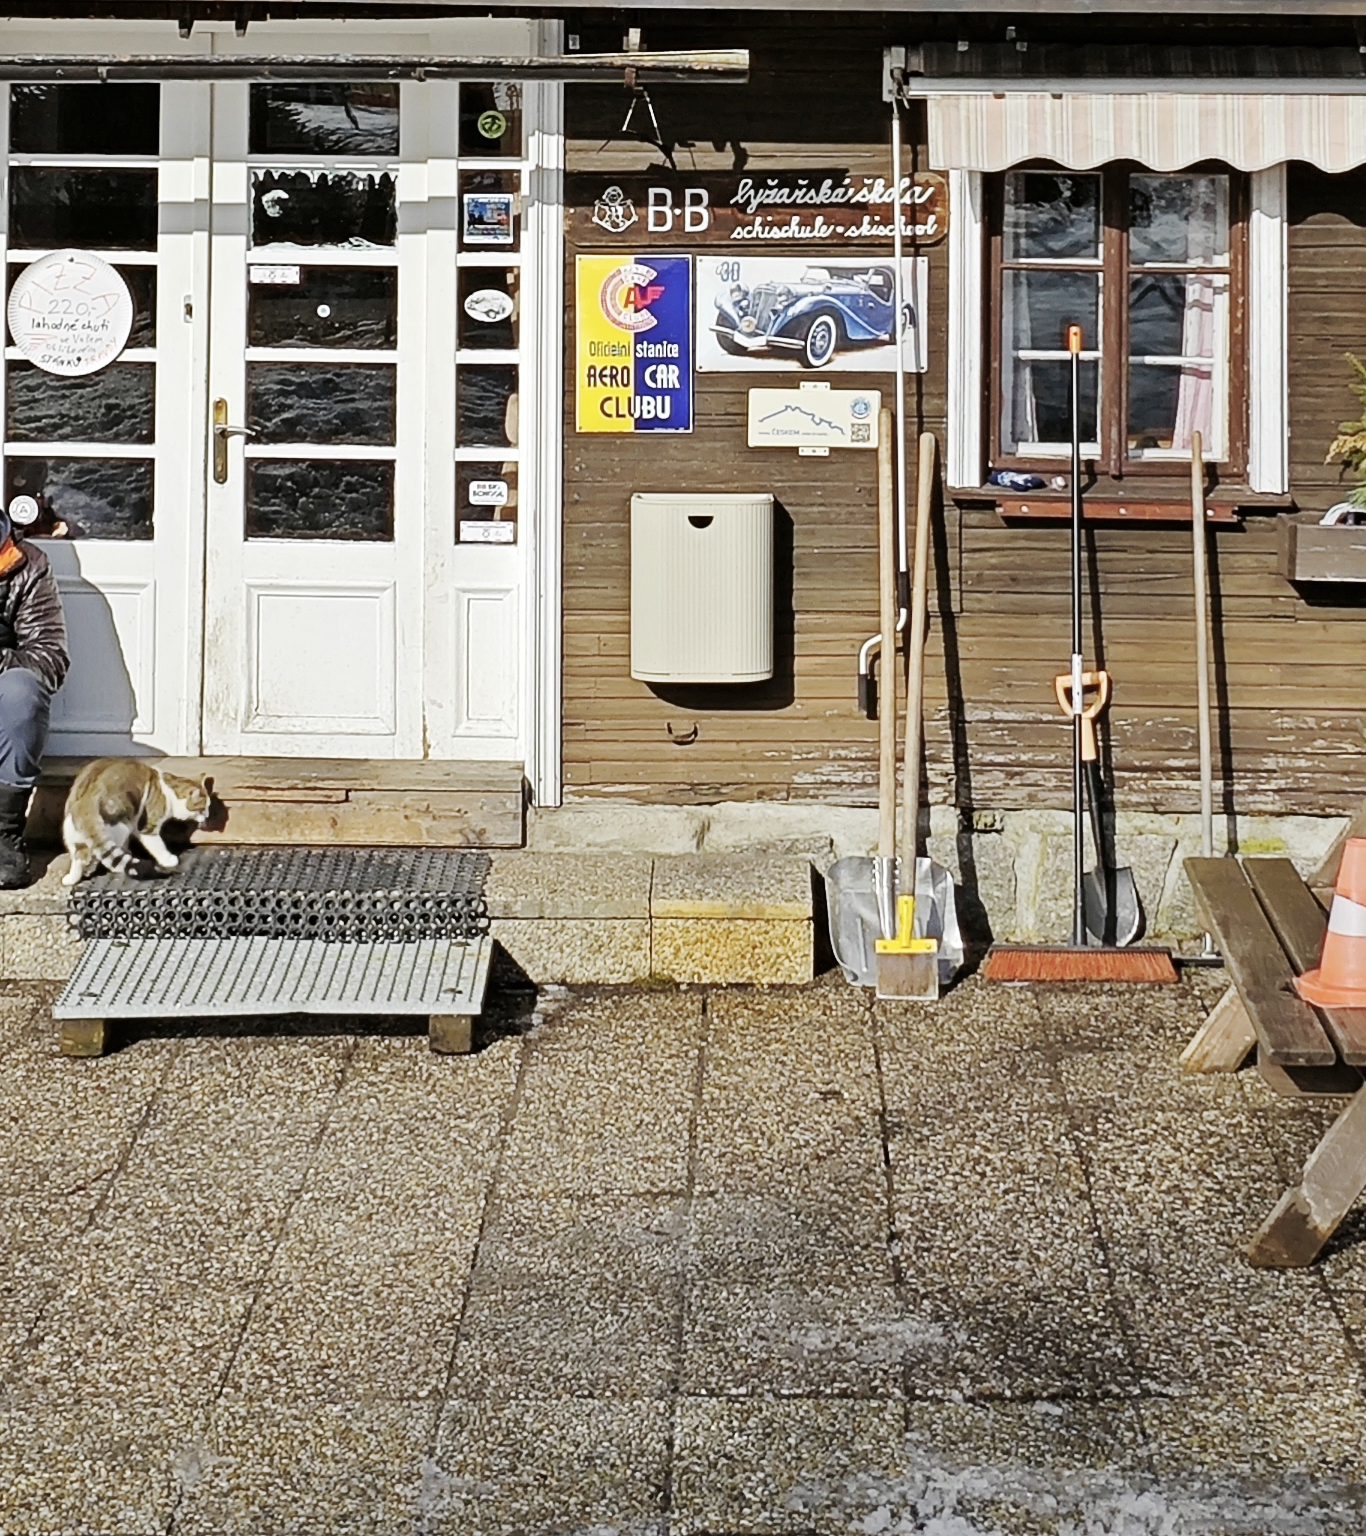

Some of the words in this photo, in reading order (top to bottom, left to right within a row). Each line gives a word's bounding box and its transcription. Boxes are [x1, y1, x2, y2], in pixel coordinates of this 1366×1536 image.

[730, 178, 854, 214] lyžařská
[850, 177, 935, 204] škola
[730, 216, 835, 239] schischule
[844, 214, 938, 237] skischool
[635, 340, 679, 358] stanice
[587, 364, 631, 388] AERO
[644, 363, 680, 389] CAR
[600, 395, 671, 419] CLUBU
